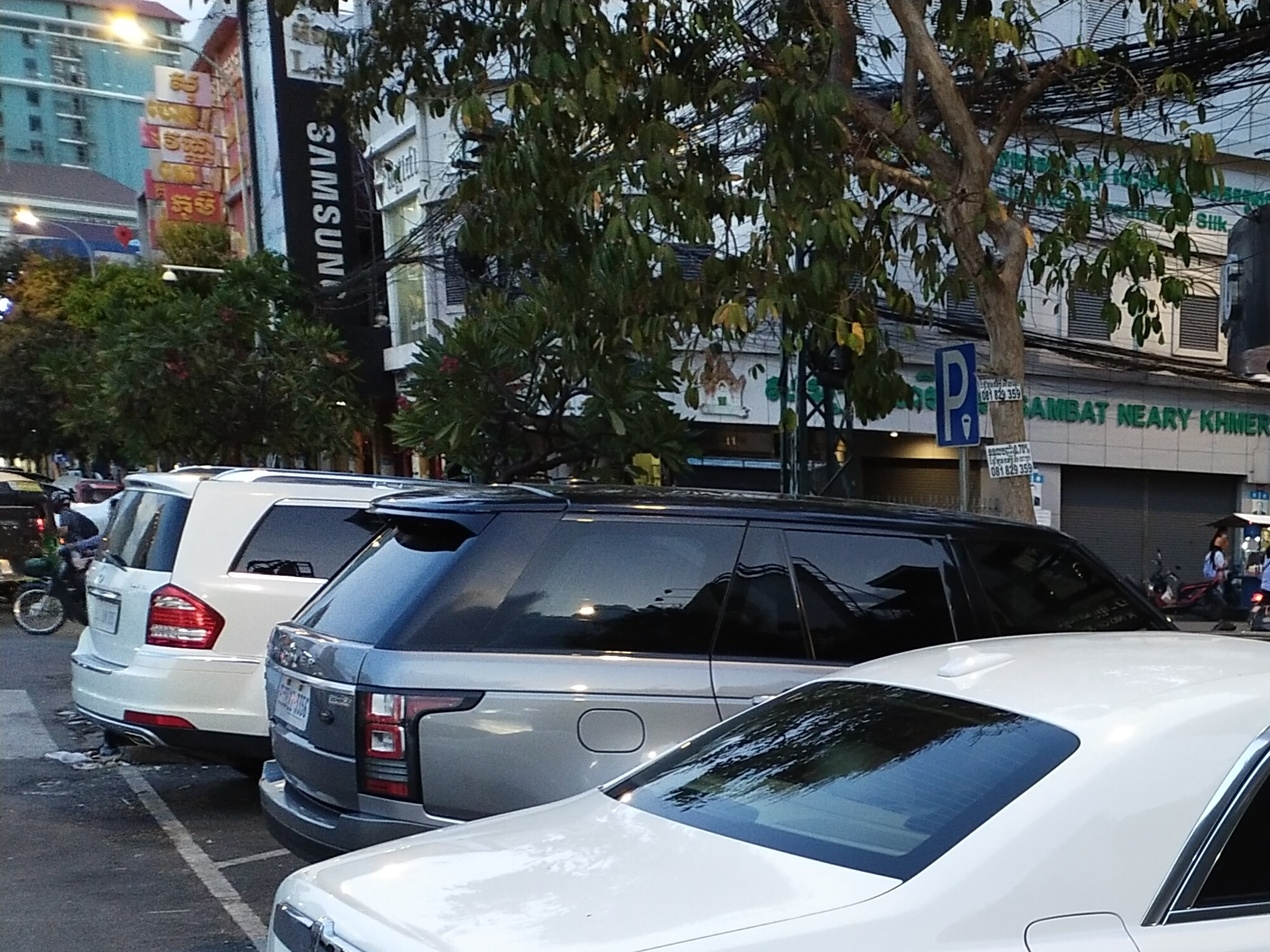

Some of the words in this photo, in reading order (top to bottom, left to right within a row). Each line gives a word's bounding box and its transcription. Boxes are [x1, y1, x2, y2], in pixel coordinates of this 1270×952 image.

[306, 121, 346, 299] SAMSUN
[1195, 212, 1228, 233] Silk
[942, 349, 969, 441] P
[1007, 387, 1021, 400] 359
[1117, 402, 1193, 431] NEARY
[990, 465, 1004, 477] 081
[1005, 464, 1019, 476] 829
[1019, 462, 1033, 474] 359
